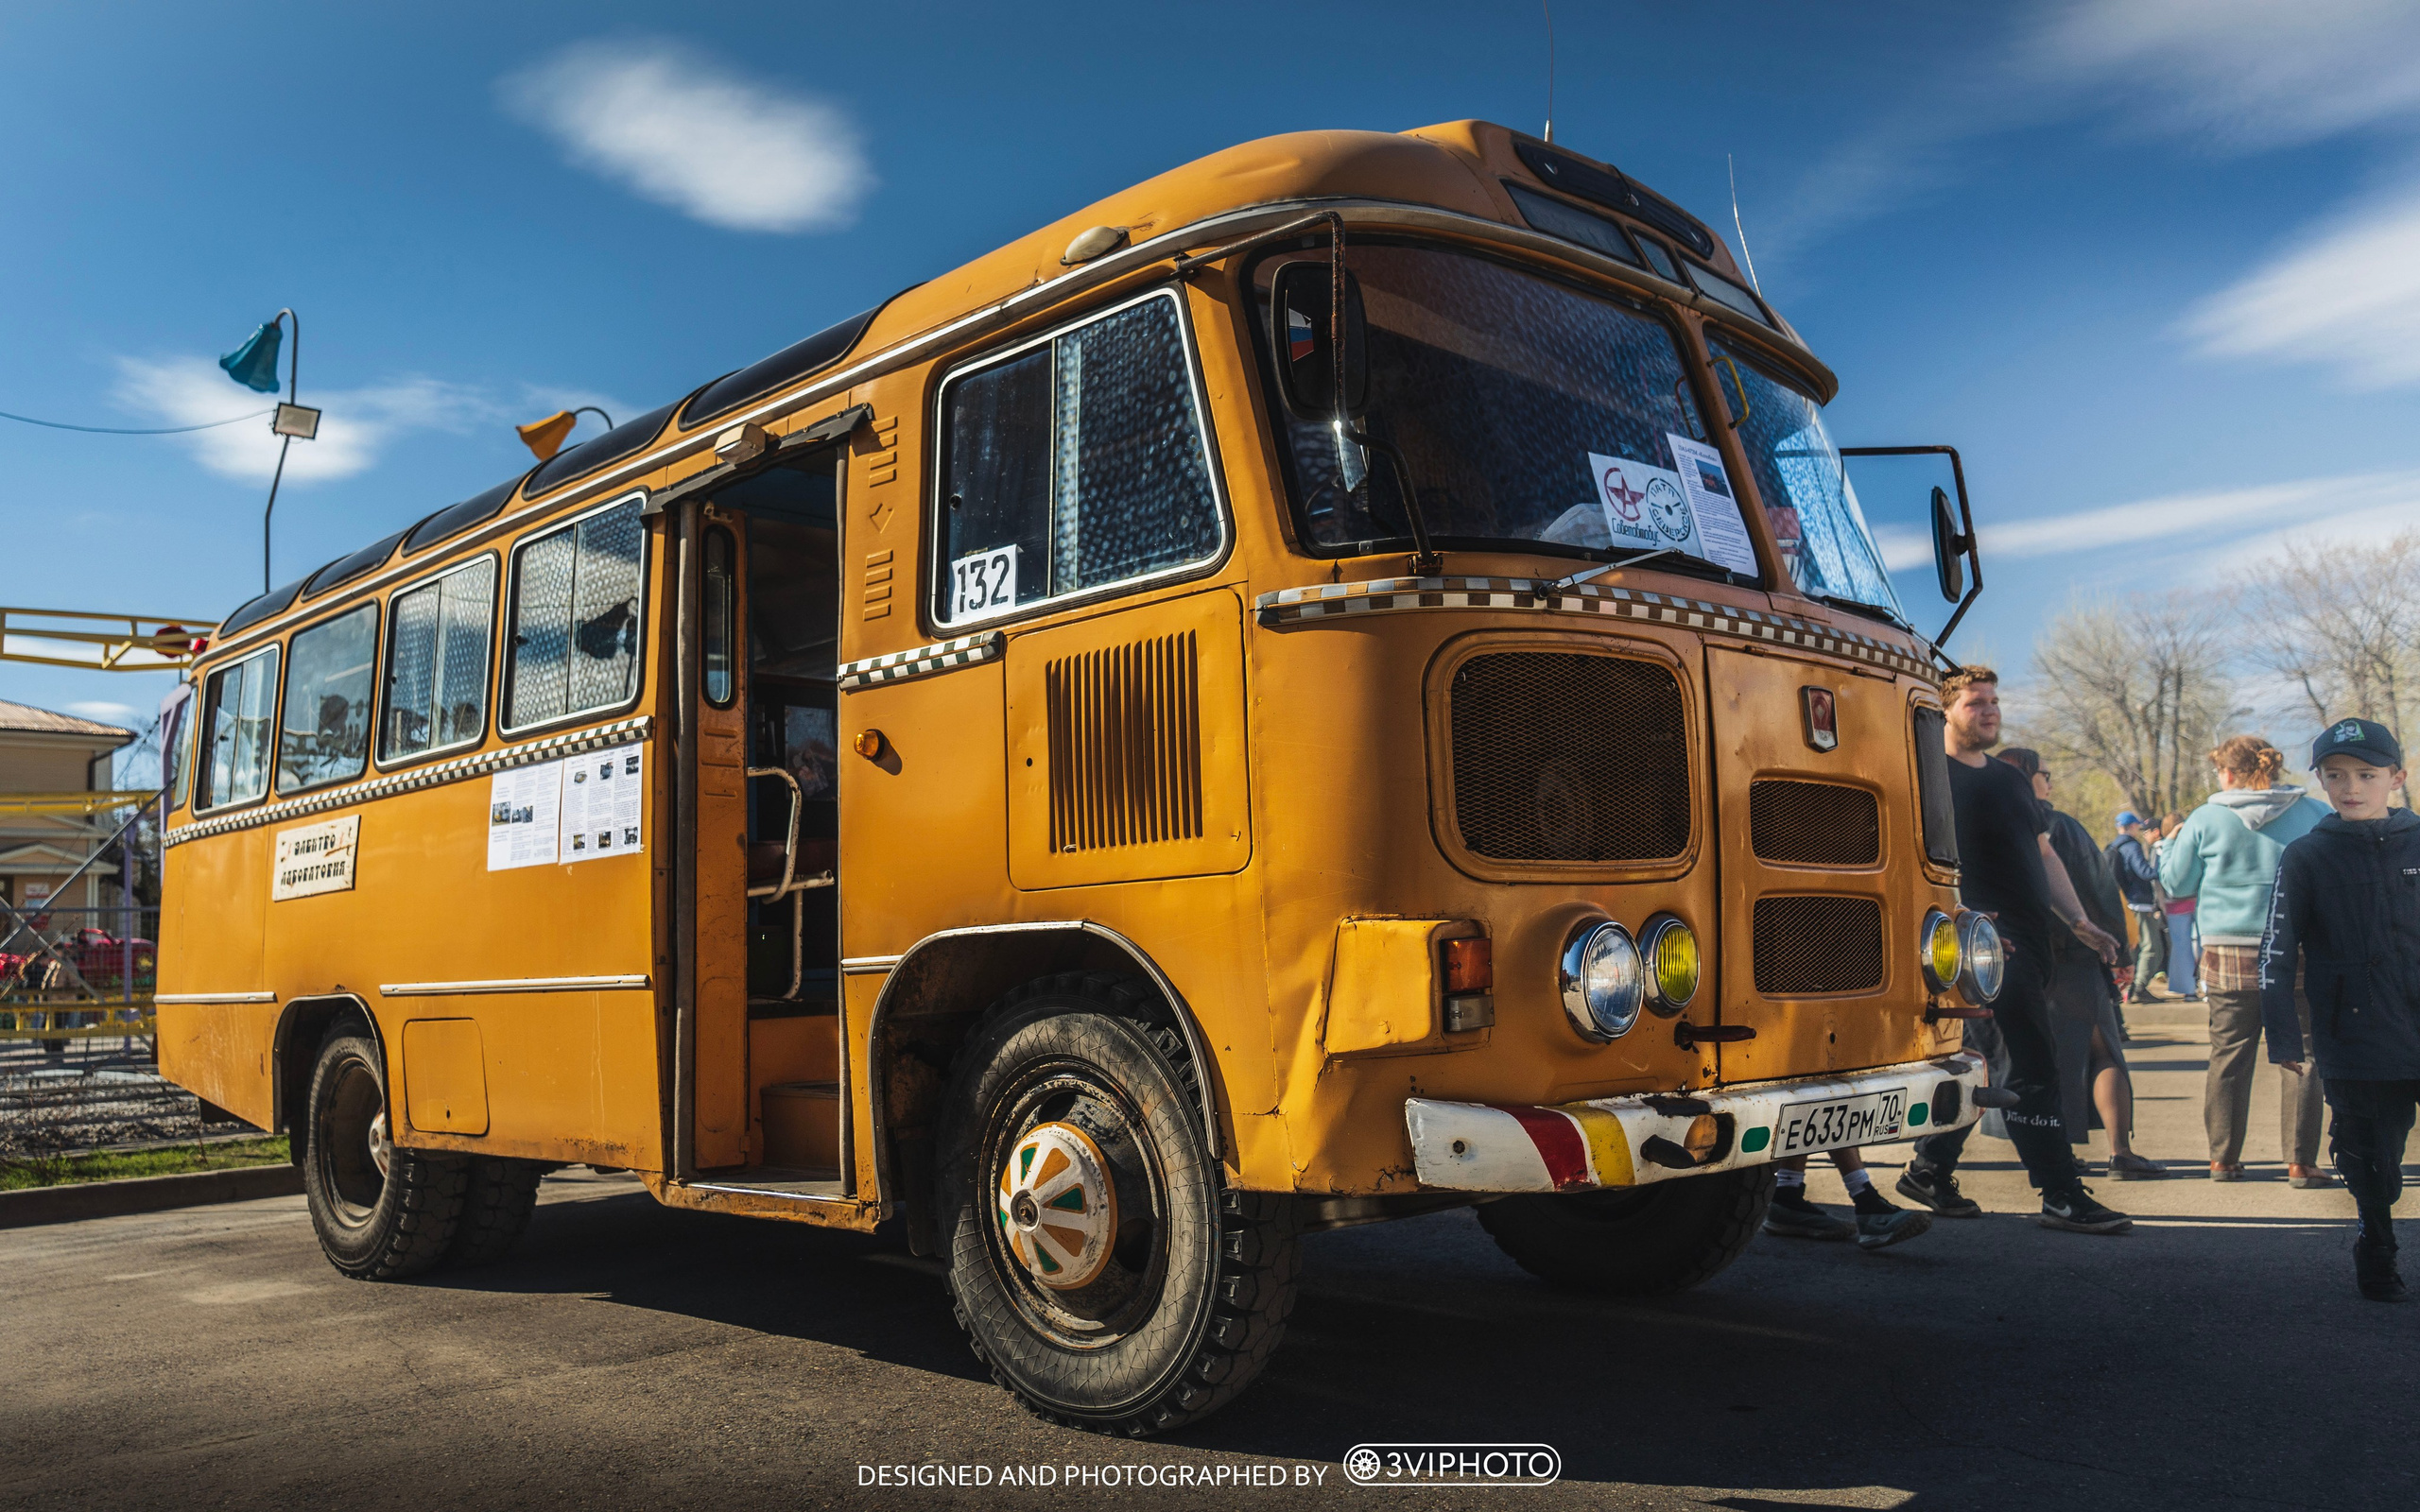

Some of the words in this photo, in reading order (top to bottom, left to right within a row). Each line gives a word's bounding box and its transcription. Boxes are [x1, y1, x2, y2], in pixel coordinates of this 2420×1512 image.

[958, 554, 1010, 613] 132
[294, 833, 336, 856] ЭЛЕКТРО
[281, 861, 346, 885] ЛАБОРАТОРИЯ
[1879, 1094, 1899, 1125] 70
[2031, 1114, 2048, 1126] do
[1875, 1125, 1889, 1136] RUS
